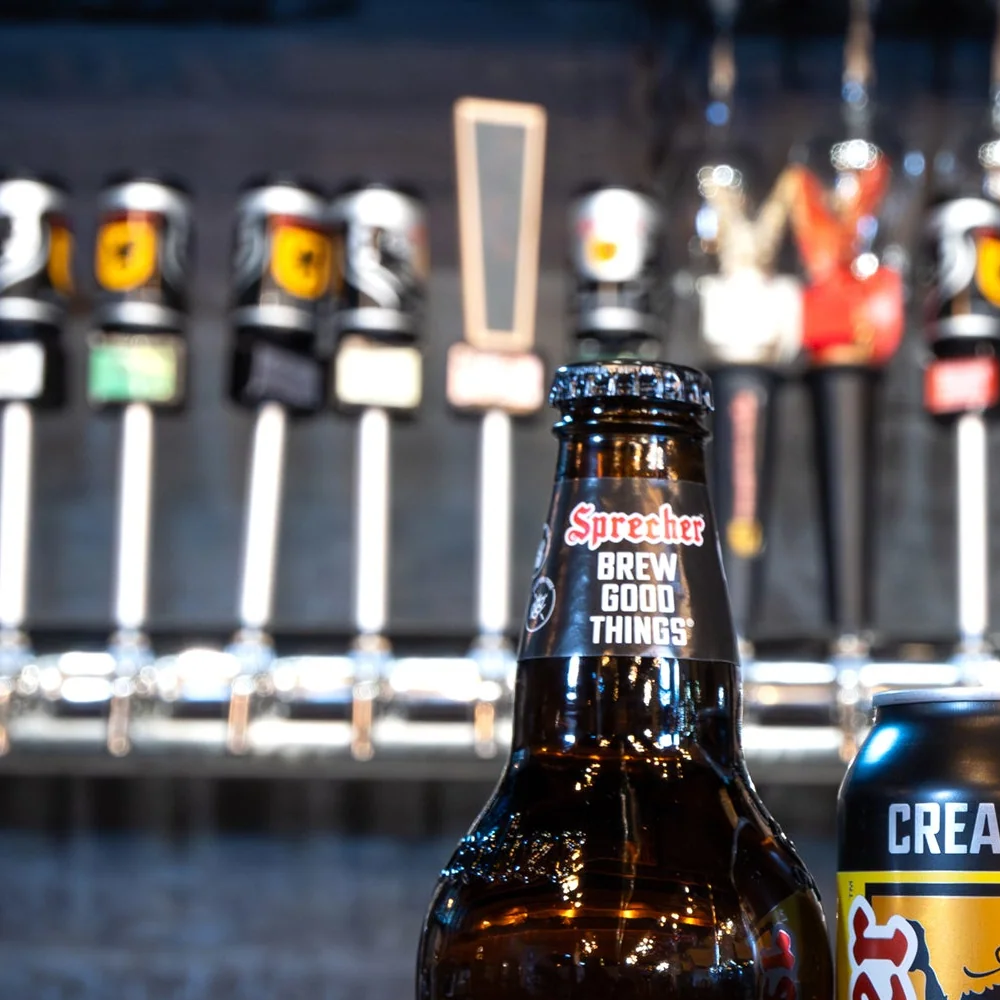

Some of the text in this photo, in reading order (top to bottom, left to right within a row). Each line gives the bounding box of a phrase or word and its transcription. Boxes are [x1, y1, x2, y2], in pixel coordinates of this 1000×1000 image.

[566, 504, 704, 548] Sprecher
[597, 552, 677, 581] BREW
[601, 584, 675, 613] GOOD
